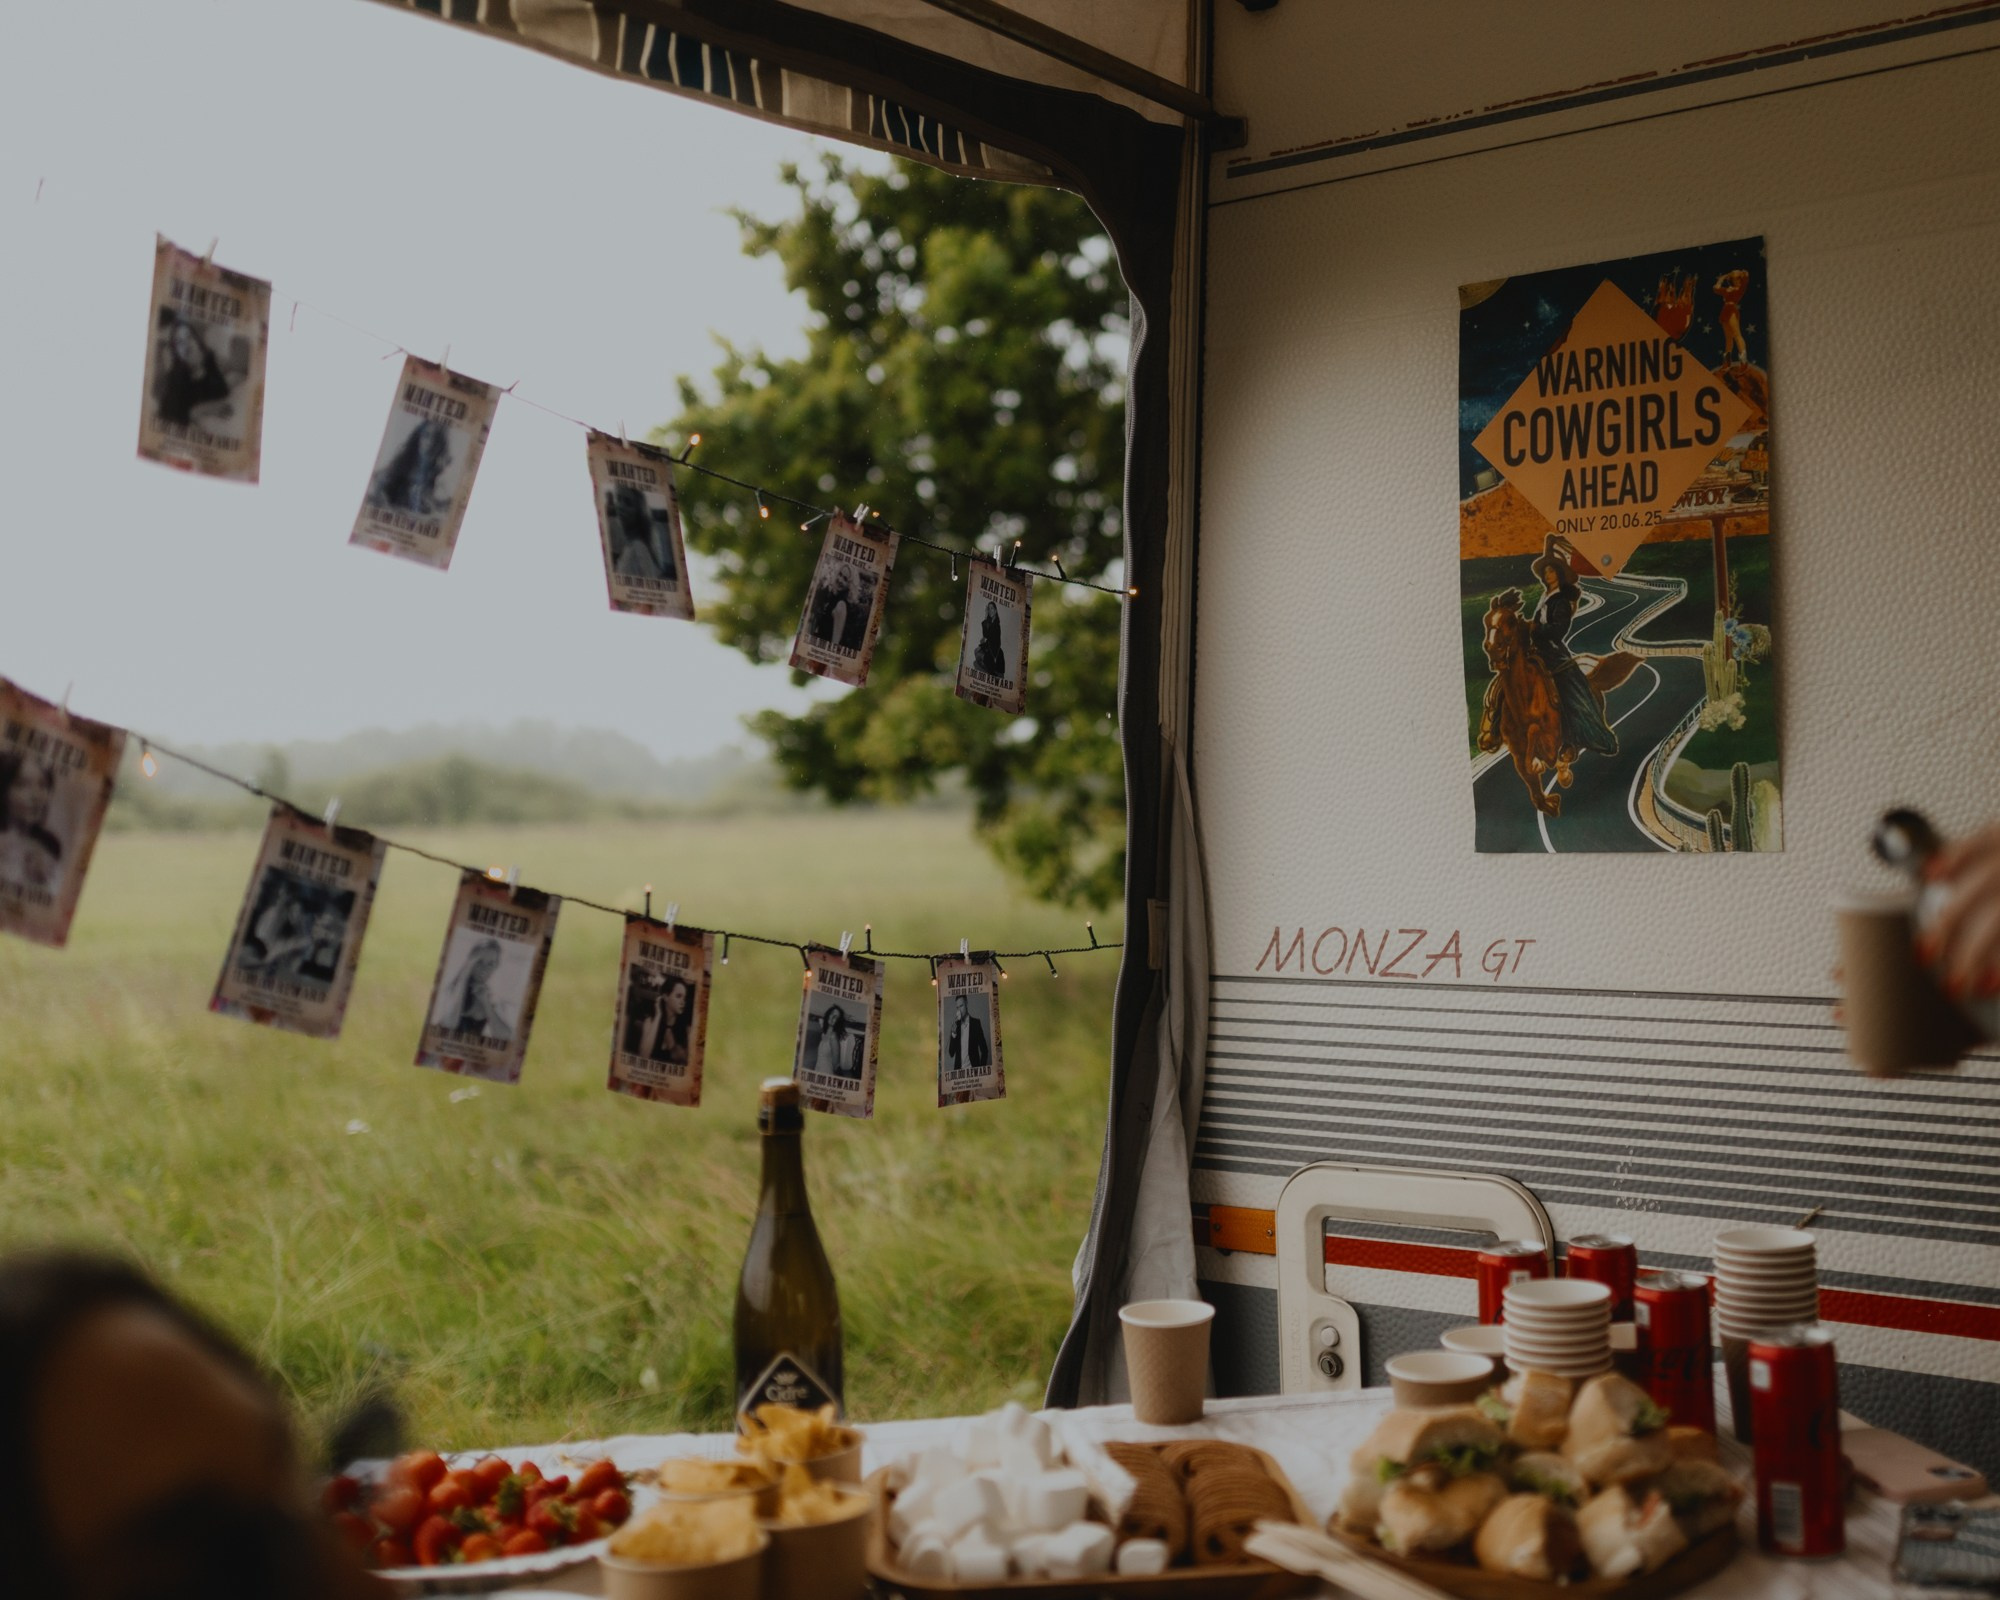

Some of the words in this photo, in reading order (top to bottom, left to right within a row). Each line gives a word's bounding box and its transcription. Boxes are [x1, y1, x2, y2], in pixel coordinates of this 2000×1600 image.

[171, 277, 242, 319] WANTED
[1537, 338, 1682, 398] WARNING
[403, 382, 468, 421] WANTED
[1503, 387, 1720, 467] COWGIRLS
[606, 459, 657, 485] WANTED
[1559, 460, 1658, 511] AHEAD
[1672, 487, 1726, 508] WBOY
[1556, 517, 1596, 534] ONLY
[1600, 510, 1662, 531] 20.06.25
[832, 534, 876, 563] WANTED
[981, 575, 1016, 602] WANTED
[986, 675, 1014, 690] REWARD
[280, 839, 352, 879] WANTED
[469, 902, 530, 935] WANTED
[639, 940, 690, 969] WANTED
[1255, 926, 1462, 979] MONZA
[1481, 939, 1536, 982] GT
[818, 967, 863, 994] WANTED
[947, 972, 983, 989] WANTED
[827, 1076, 860, 1092] REWARD
[965, 1066, 992, 1079] REWARD
